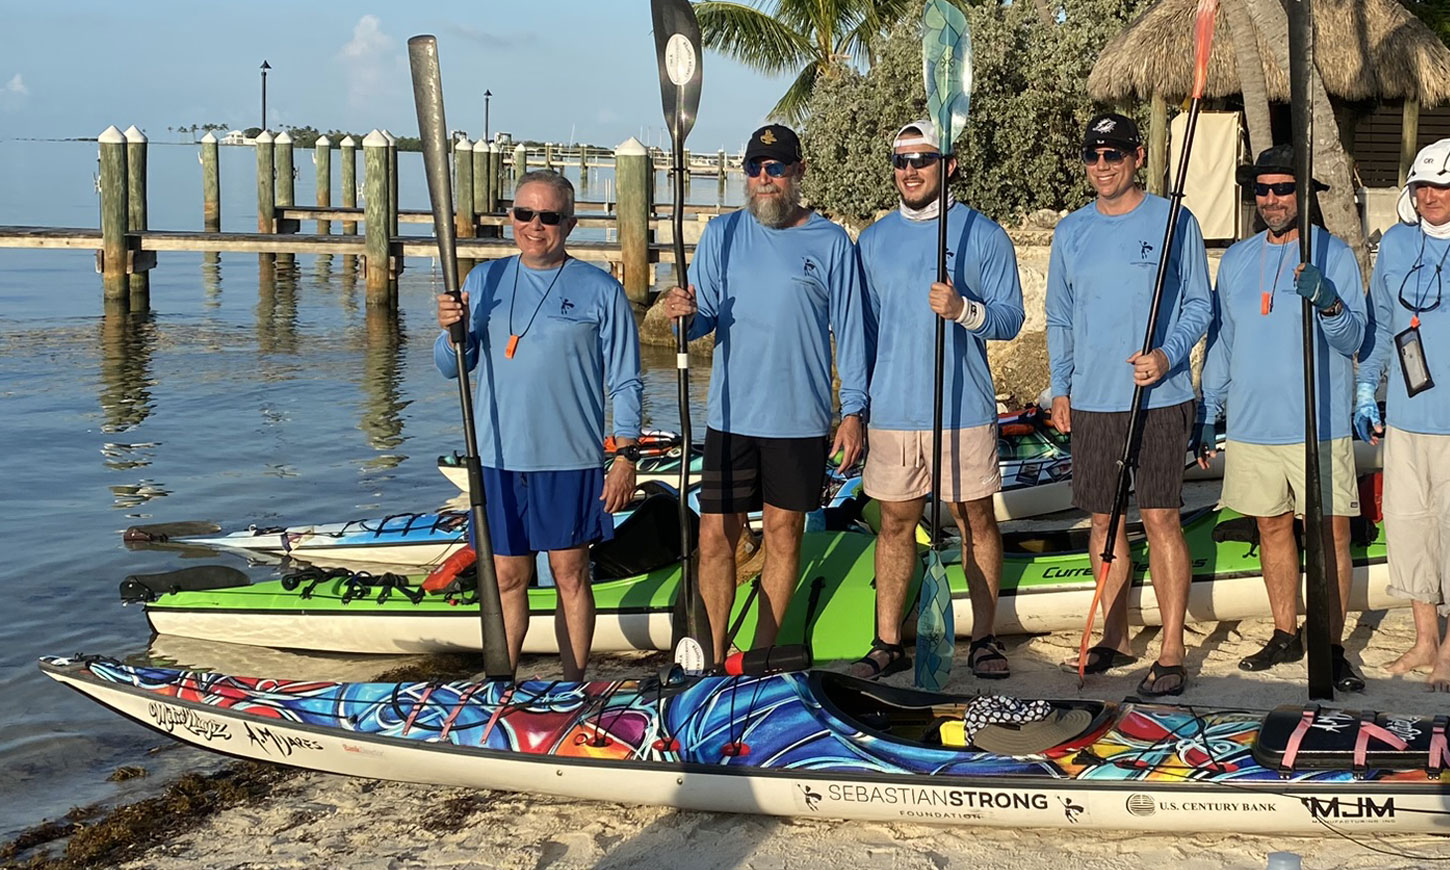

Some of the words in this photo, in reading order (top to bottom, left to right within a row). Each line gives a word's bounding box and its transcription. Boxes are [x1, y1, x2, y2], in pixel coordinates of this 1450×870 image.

[1042, 565, 1094, 579] Curre
[1159, 802, 1180, 811] U.S.
[1182, 802, 1239, 812] CENTURY
[1243, 802, 1277, 812] BANK
[1310, 797, 1395, 818] MJM
[899, 810, 983, 820] FOUNDATION
